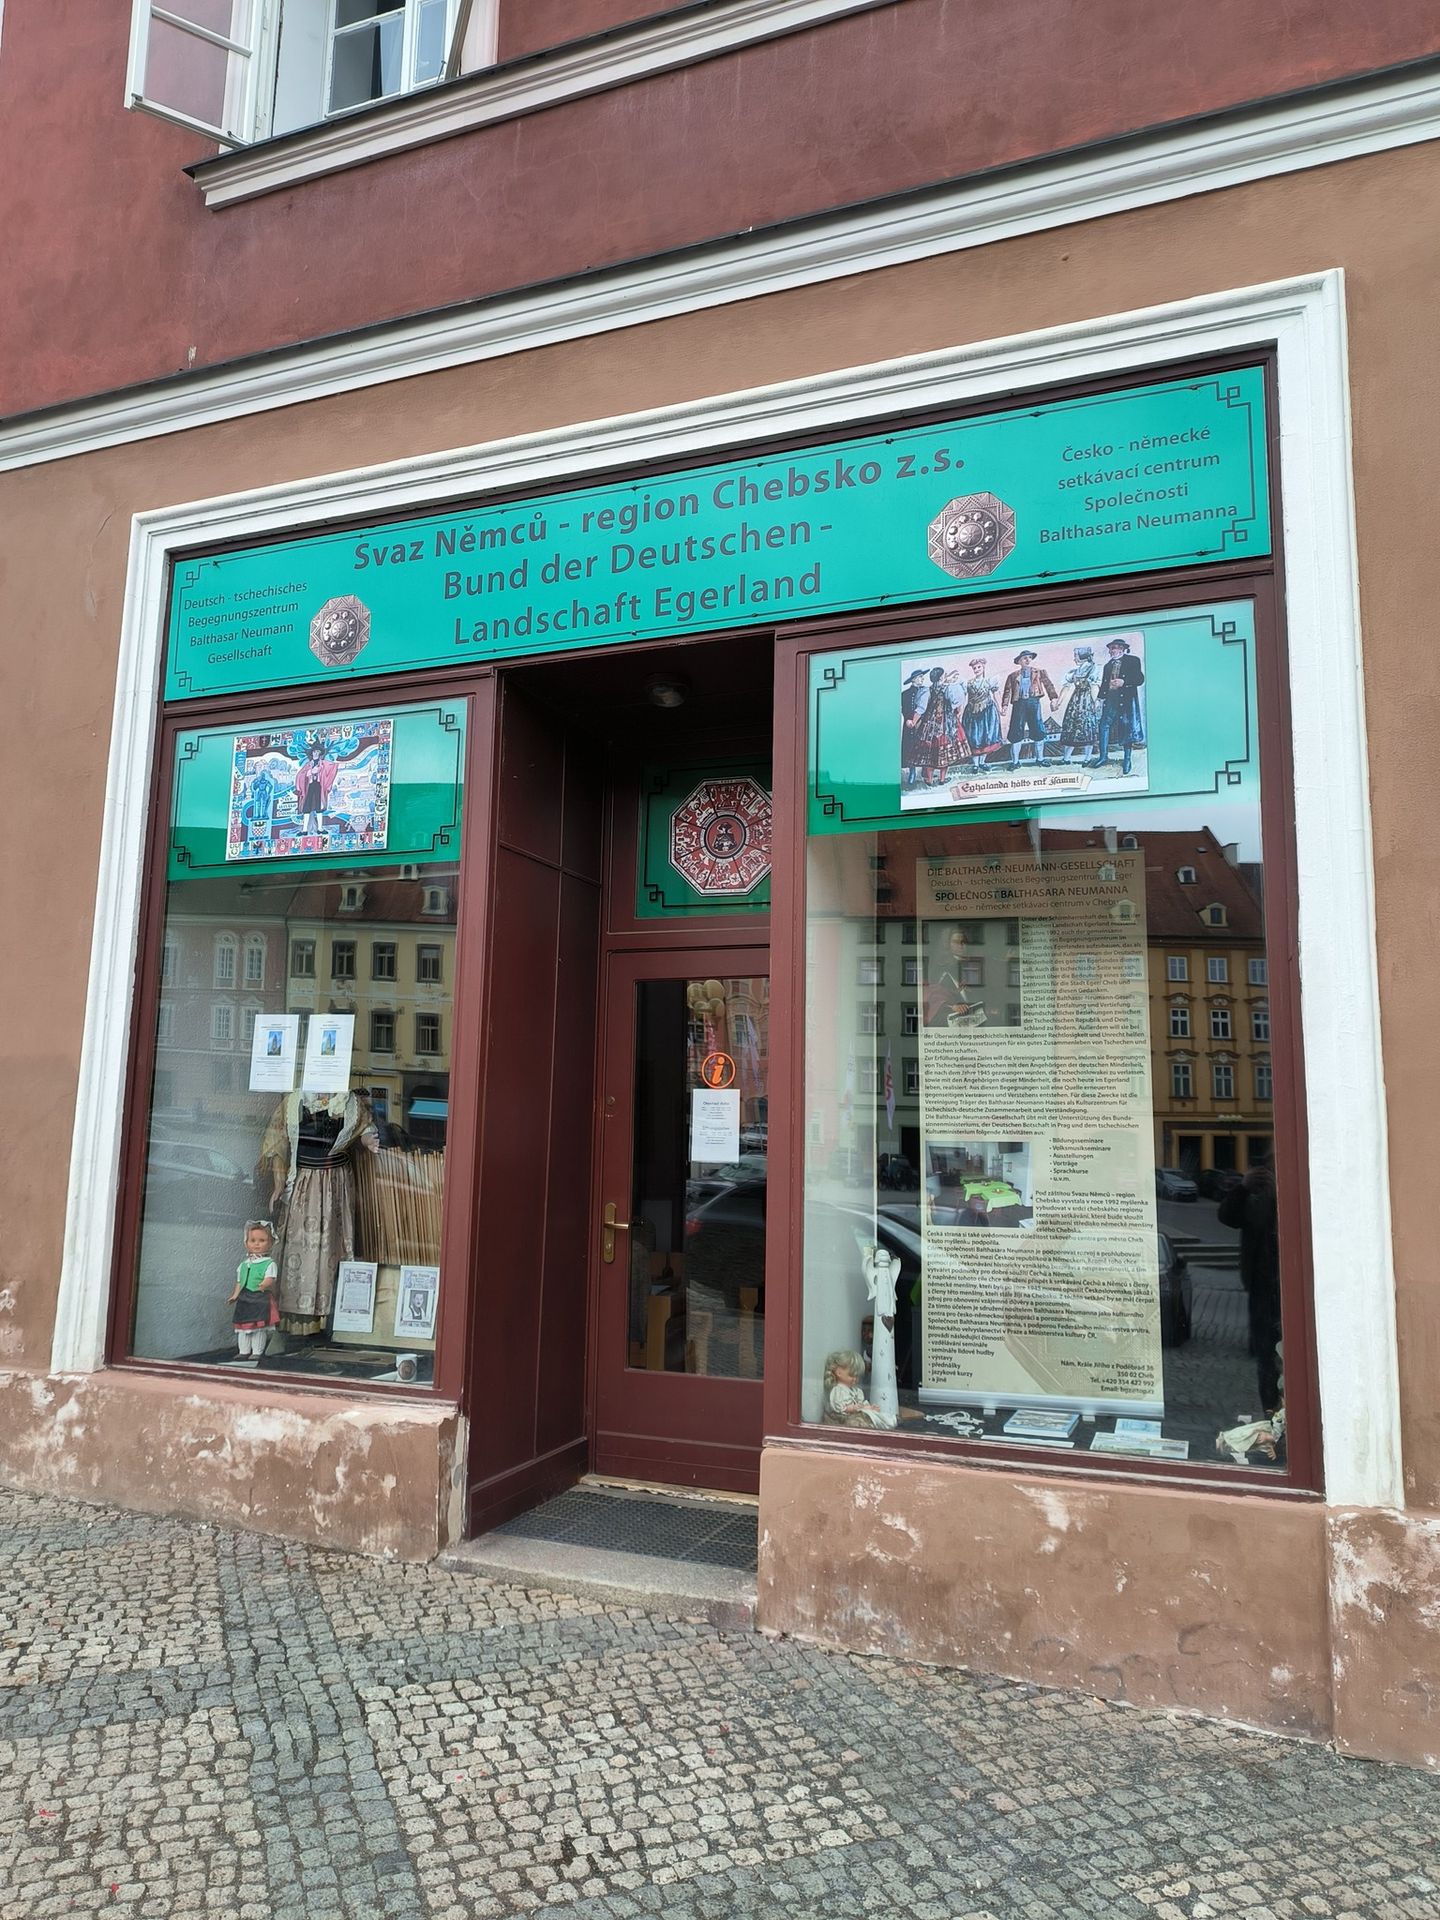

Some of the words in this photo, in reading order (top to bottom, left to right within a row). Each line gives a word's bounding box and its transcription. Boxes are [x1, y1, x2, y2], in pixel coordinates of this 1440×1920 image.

[1061, 445, 1114, 462] Česko
[1129, 426, 1211, 451] německé
[1057, 463, 1139, 490] setkávací
[1143, 453, 1220, 475] centrum
[354, 541, 424, 570] Svaz
[434, 512, 547, 557] Němců
[581, 493, 699, 535] region
[713, 458, 882, 509] Chebsko
[896, 447, 965, 480] z.s.
[1084, 482, 1189, 512] Společnosti
[1040, 519, 1132, 544] Balthasara
[1136, 505, 1238, 529] Neumanna
[444, 555, 528, 600] Bund
[540, 554, 598, 584] der
[611, 521, 811, 574] Deutschen
[183, 594, 225, 610] Deutsch
[234, 582, 308, 602] tschechisches
[454, 592, 641, 645] Landschaft
[655, 562, 821, 622] Egerland
[188, 602, 299, 628] Begegnungszentrum
[190, 632, 239, 647] Balthasar
[241, 623, 294, 639] Neumann
[208, 644, 272, 664] Gesellschaft
[935, 888, 999, 901] SPOLEČNOST
[1000, 887, 1066, 898] BALTHASARA
[1067, 885, 1128, 896] NEUMANNA
[1052, 1152, 1094, 1160] Ausstellungen
[1052, 1159, 1078, 1168] Vorträge
[1053, 1167, 1089, 1175] Sprachkurse
[931, 1354, 953, 1363] výstavy
